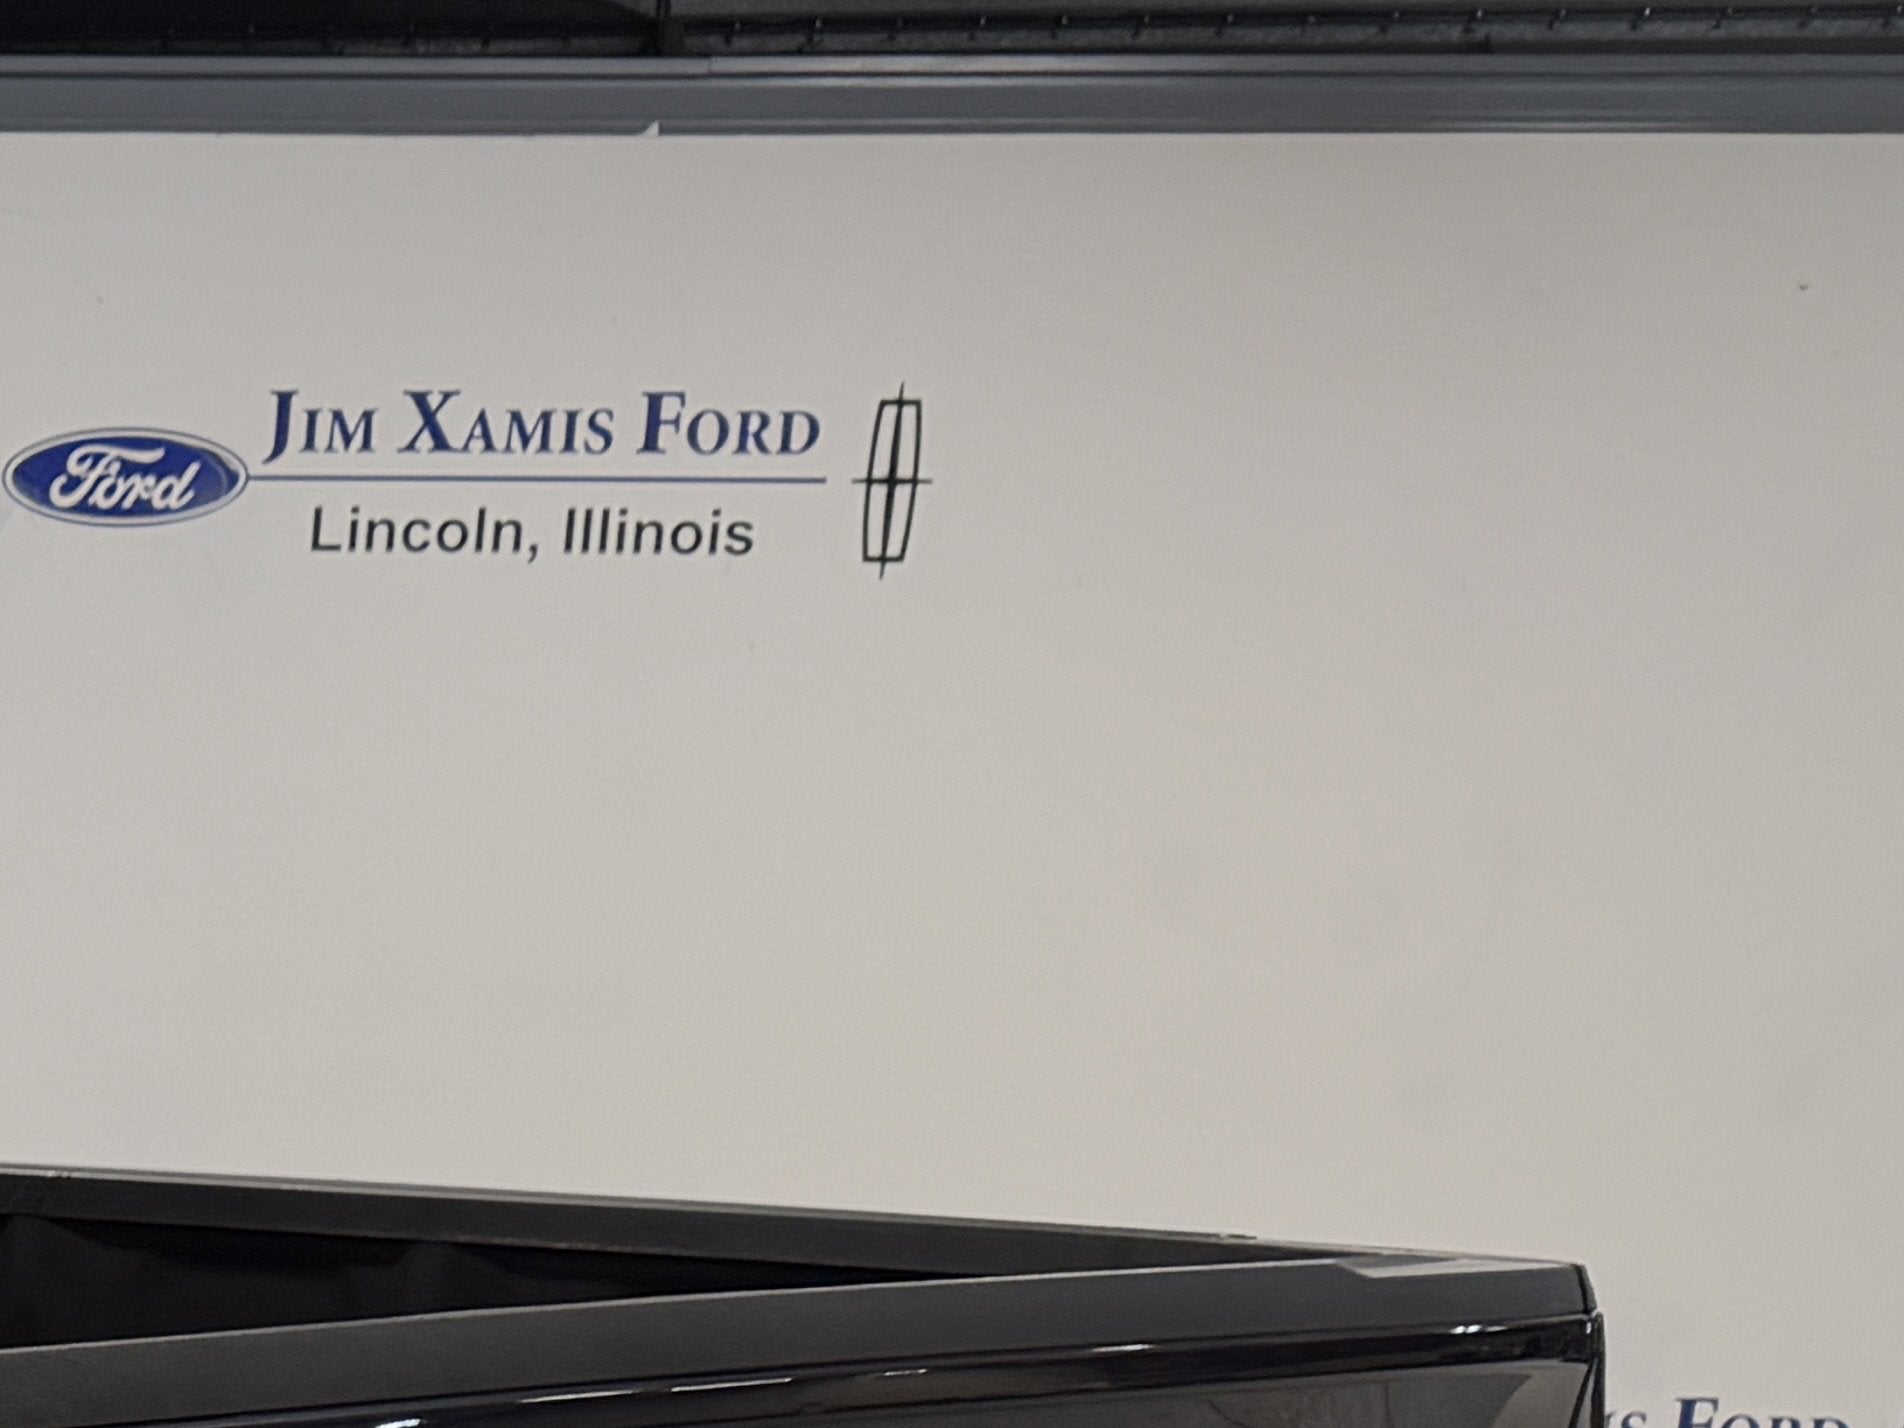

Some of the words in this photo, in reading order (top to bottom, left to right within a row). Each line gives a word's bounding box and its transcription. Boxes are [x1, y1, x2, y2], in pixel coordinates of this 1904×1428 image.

[262, 391, 378, 464] JIM
[396, 391, 614, 456] XAMIS
[635, 391, 821, 457] FORD
[47, 444, 197, 510] Ford
[309, 507, 539, 563] Lincoln,
[563, 507, 755, 557] Illinois
